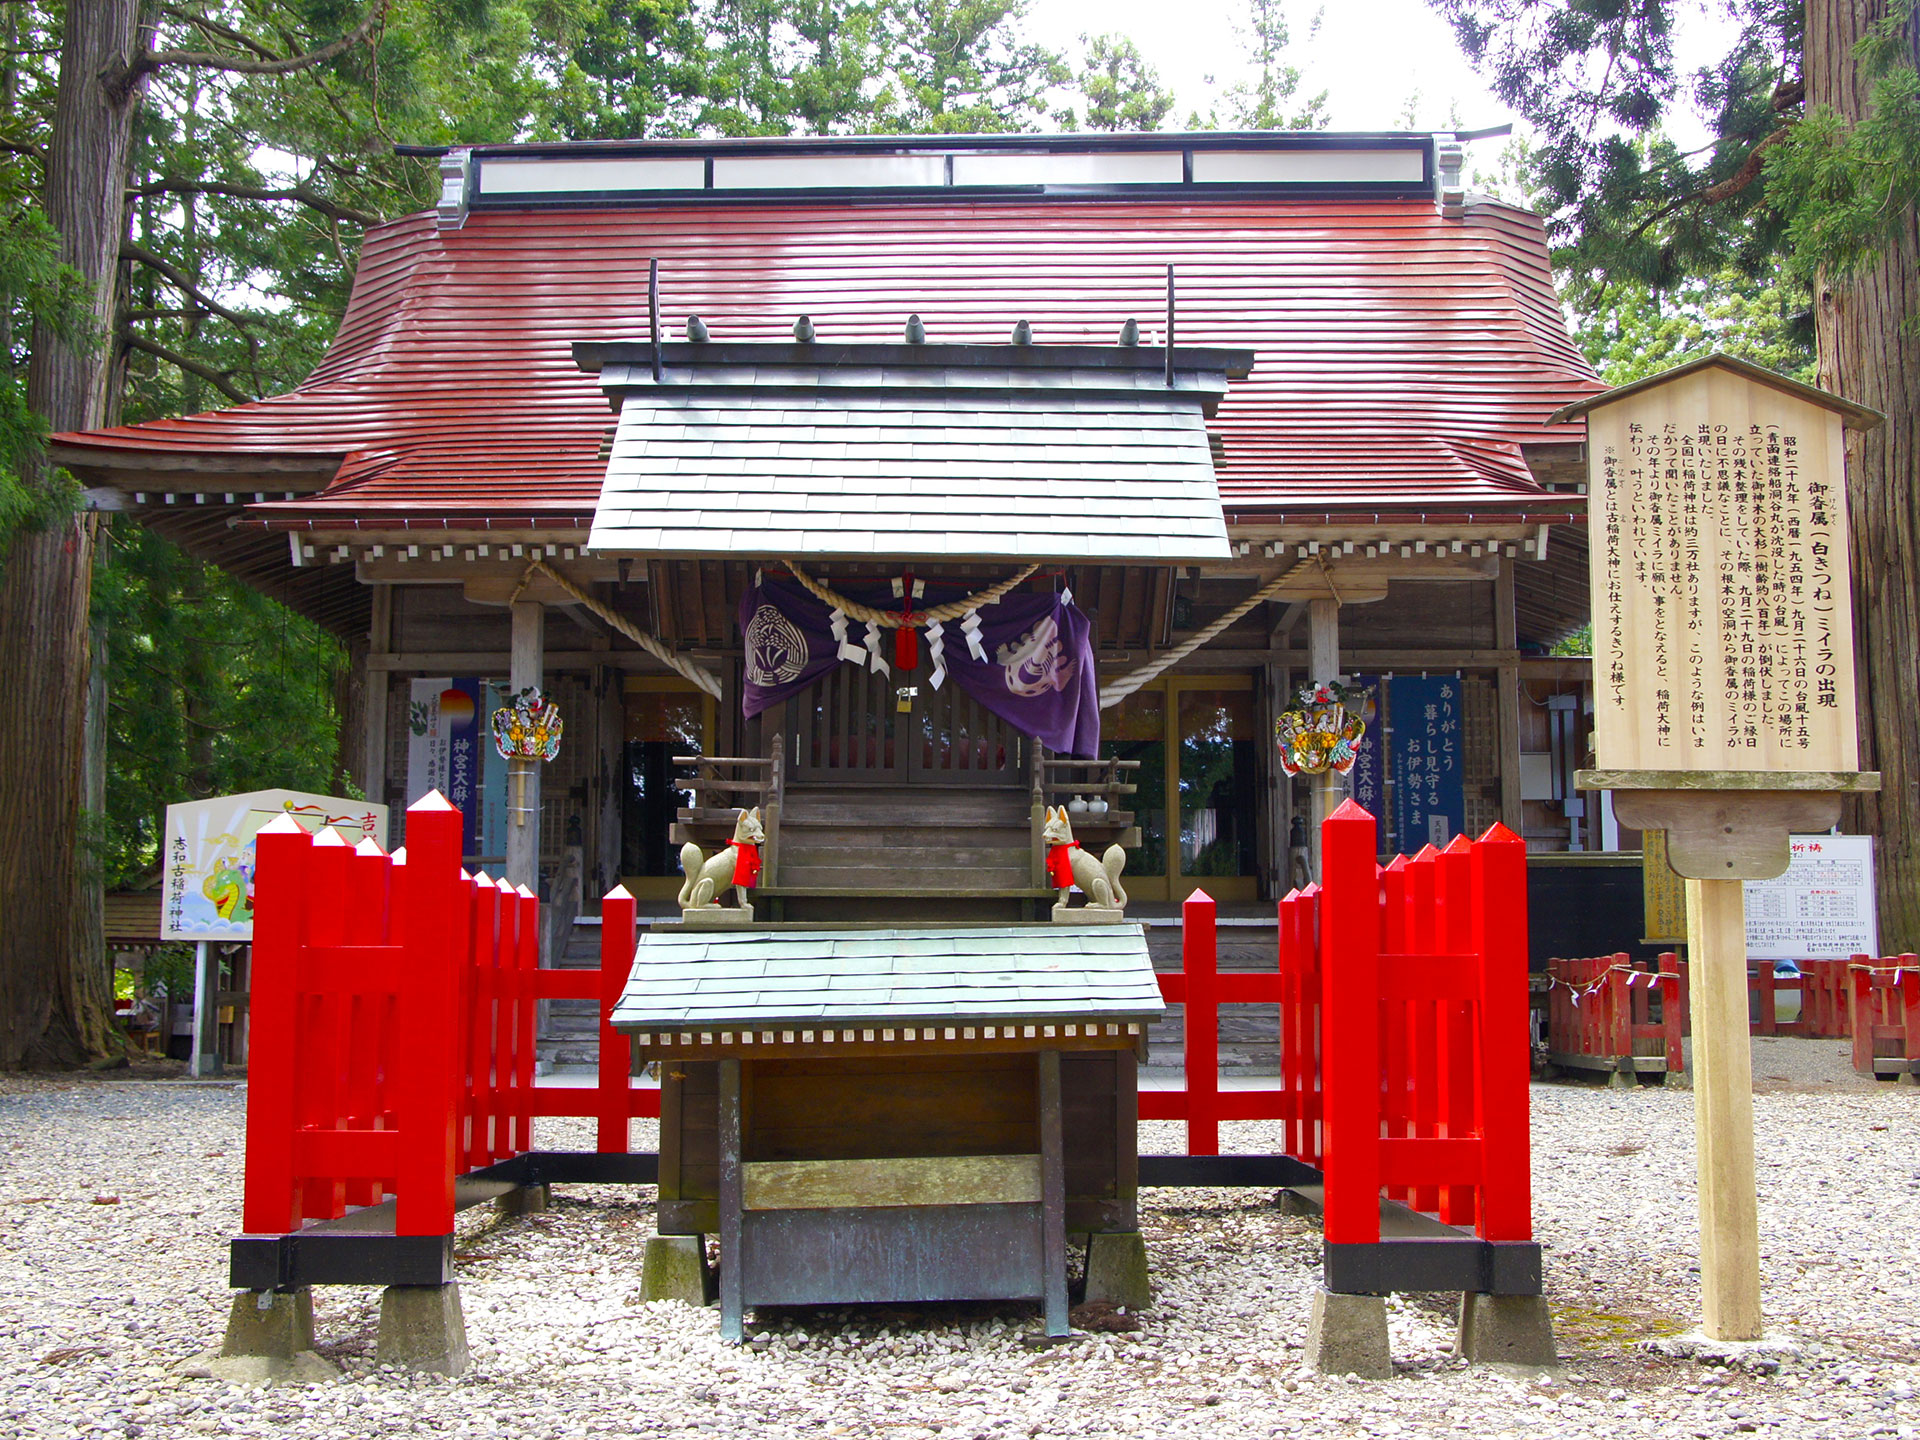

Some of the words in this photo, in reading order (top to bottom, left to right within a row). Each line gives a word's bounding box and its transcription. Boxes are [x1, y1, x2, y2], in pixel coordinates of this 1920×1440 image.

[1698, 423, 1714, 520] 出現いたしました。
[1423, 704, 1440, 805] 暮らし見守る
[1440, 684, 1456, 772] ありがとう
[1407, 738, 1423, 825] お伊勢さま
[168, 837, 188, 932] 志和古稲荷神社
